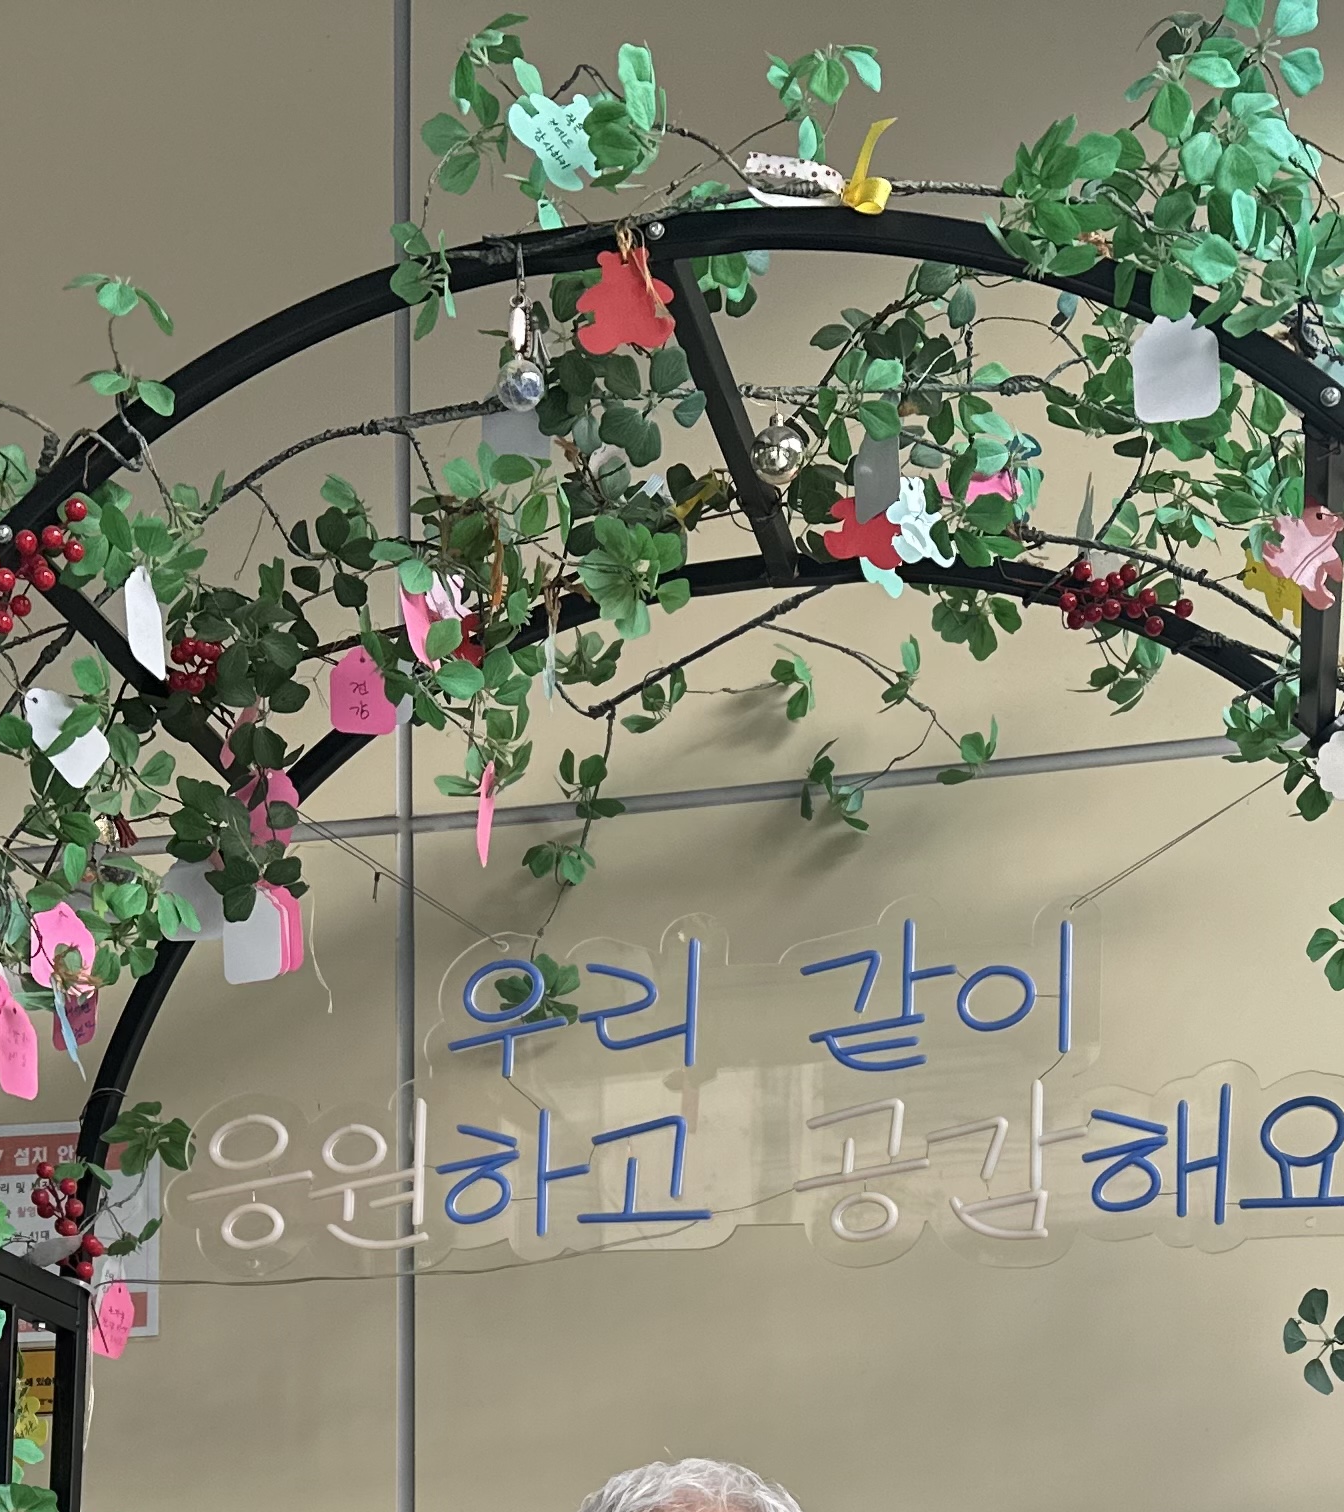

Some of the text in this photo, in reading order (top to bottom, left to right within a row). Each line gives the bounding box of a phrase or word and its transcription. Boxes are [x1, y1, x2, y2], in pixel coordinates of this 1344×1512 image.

[447, 918, 1073, 1078] 우리 같이
[14, 1146, 47, 1166] 설치
[57, 1144, 77, 1163] 안
[16, 1182, 26, 1194] 및
[187, 1098, 712, 1250] 응원하고
